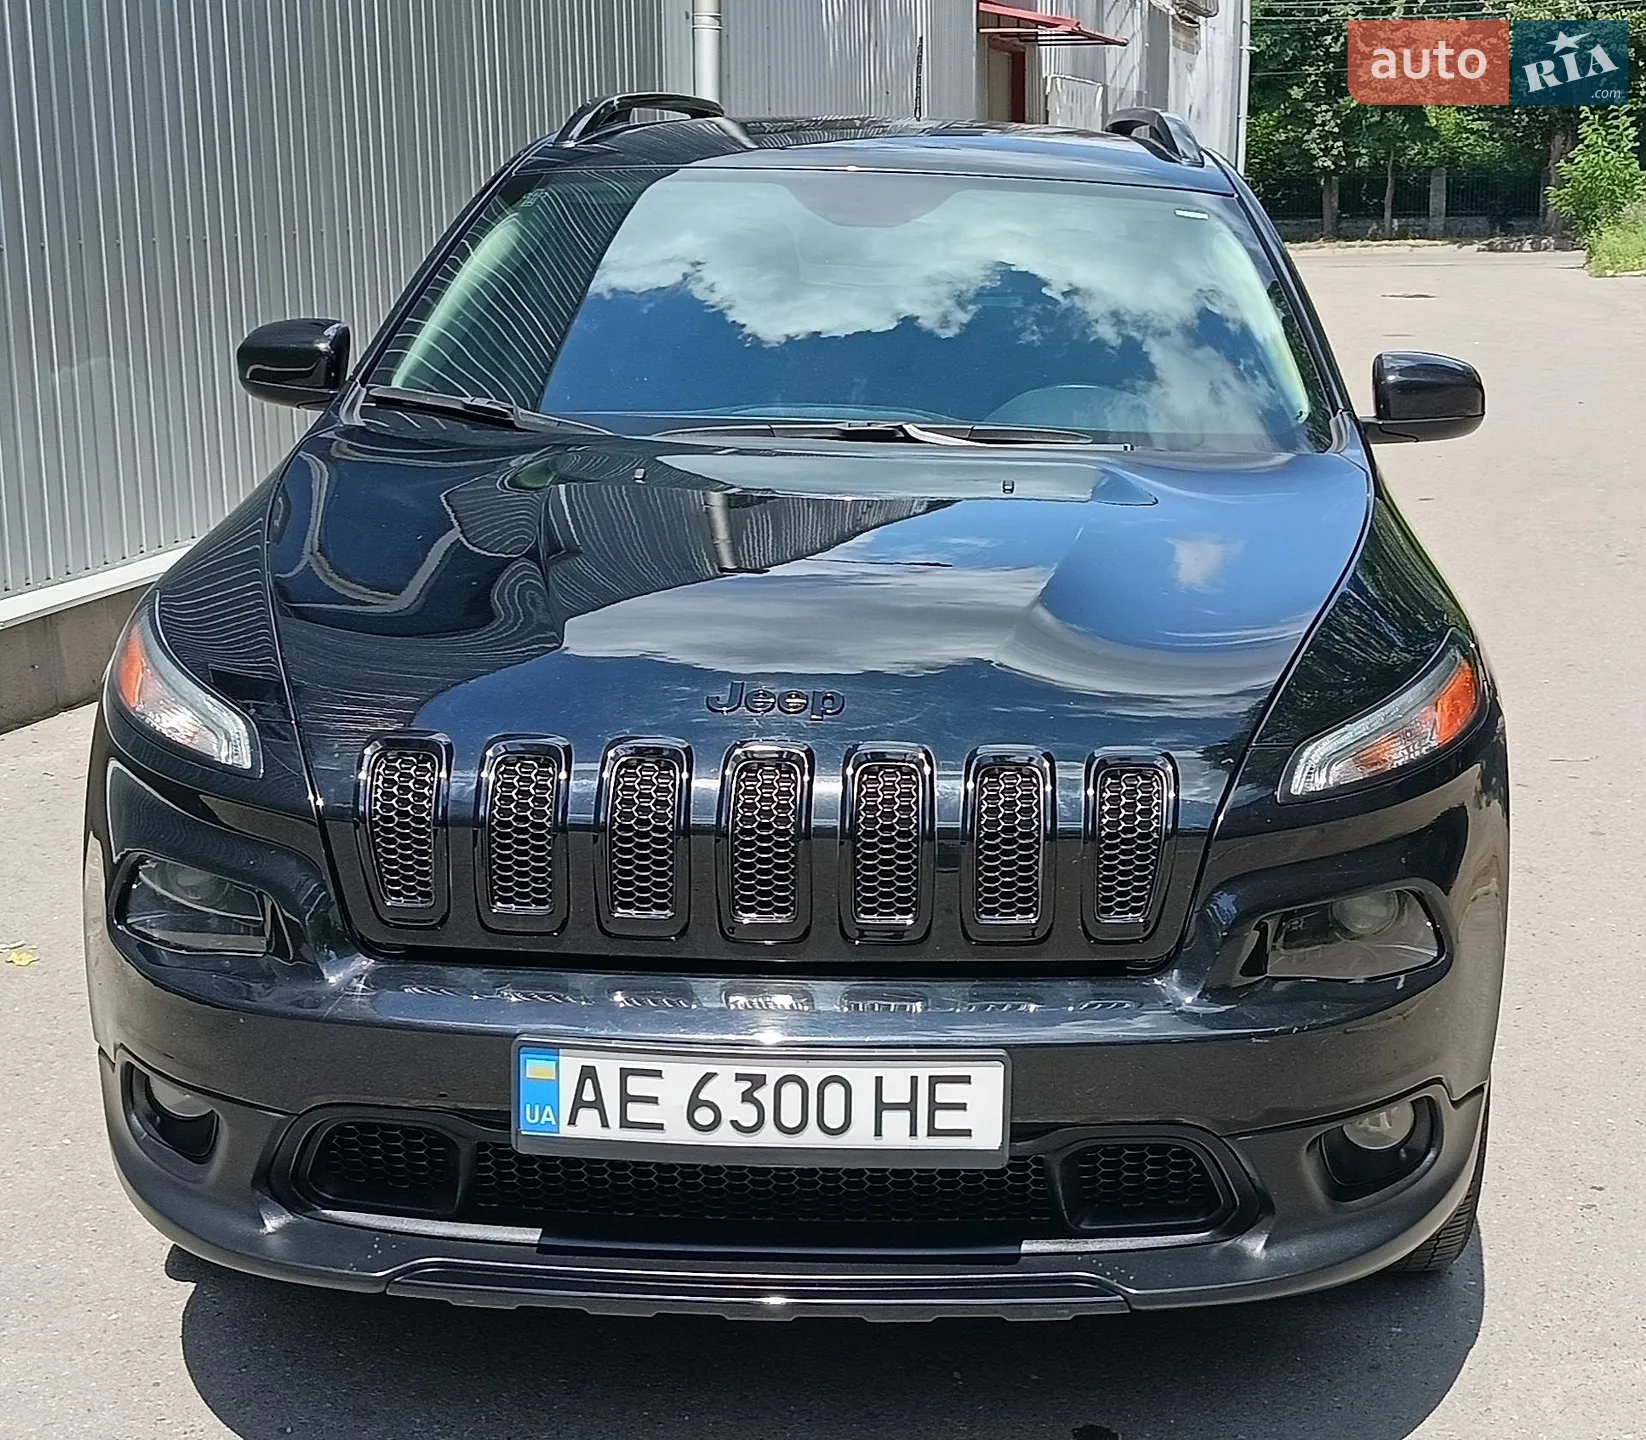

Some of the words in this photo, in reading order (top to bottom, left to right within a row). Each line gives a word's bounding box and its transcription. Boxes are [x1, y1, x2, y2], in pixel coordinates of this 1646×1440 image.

[706, 681, 845, 721] Jeep
[525, 1103, 557, 1126] UA
[567, 1064, 665, 1131] AE
[685, 1071, 853, 1137] 6300
[874, 1074, 972, 1138] HE
